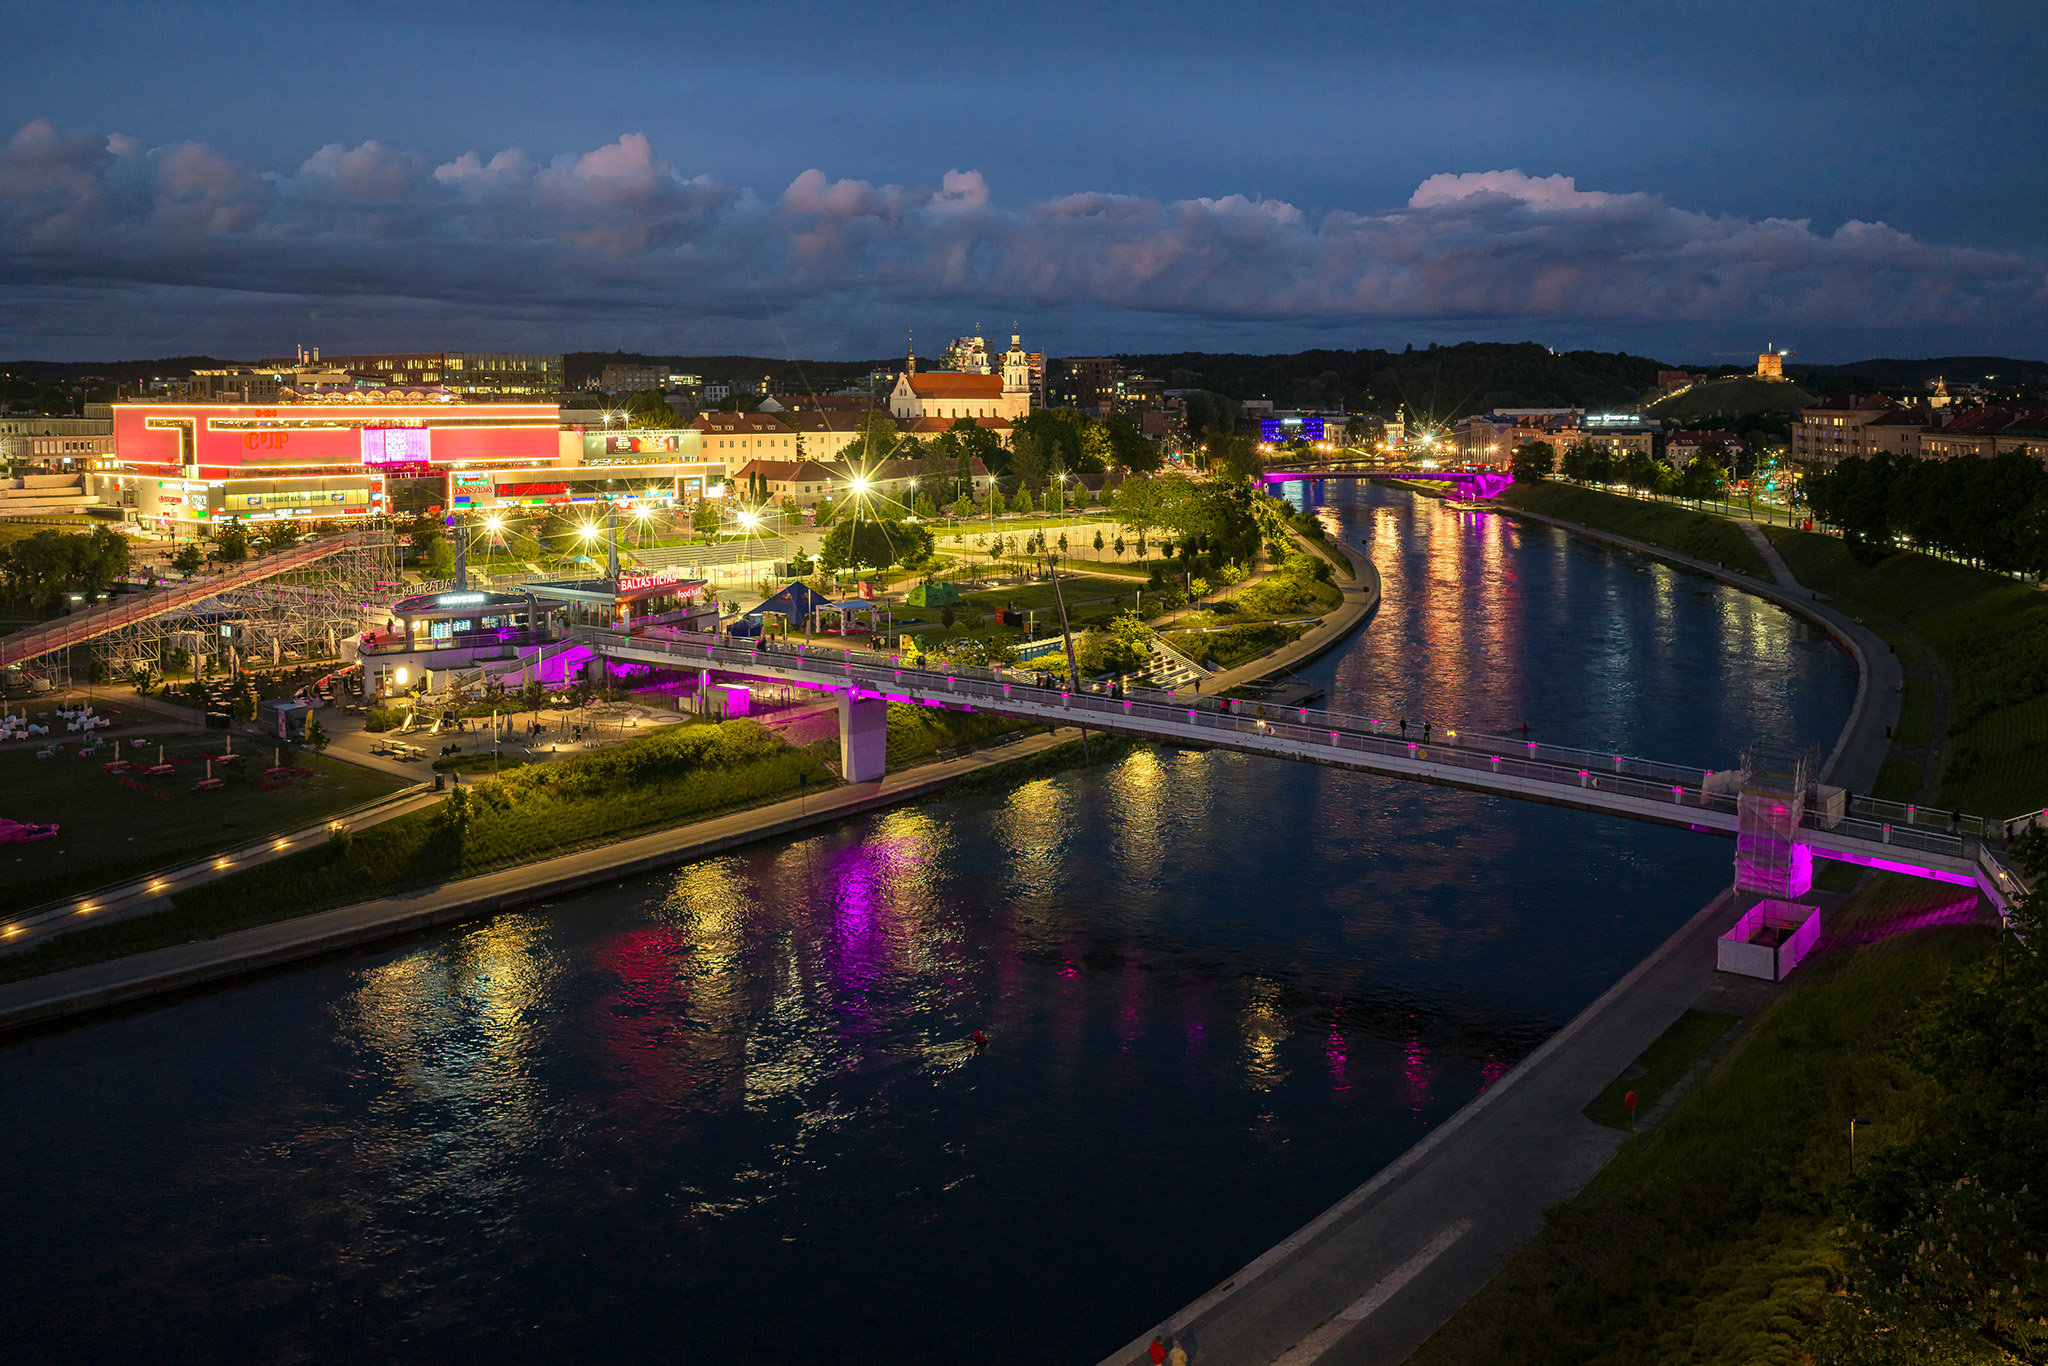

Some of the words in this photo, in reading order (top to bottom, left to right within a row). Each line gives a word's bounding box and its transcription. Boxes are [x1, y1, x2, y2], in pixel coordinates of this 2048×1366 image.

[244, 431, 289, 450] CUP
[621, 577, 651, 591] BALTAS
[652, 573, 677, 586] TILTAS
[677, 588, 691, 599] food
[692, 587, 702, 597] hall
